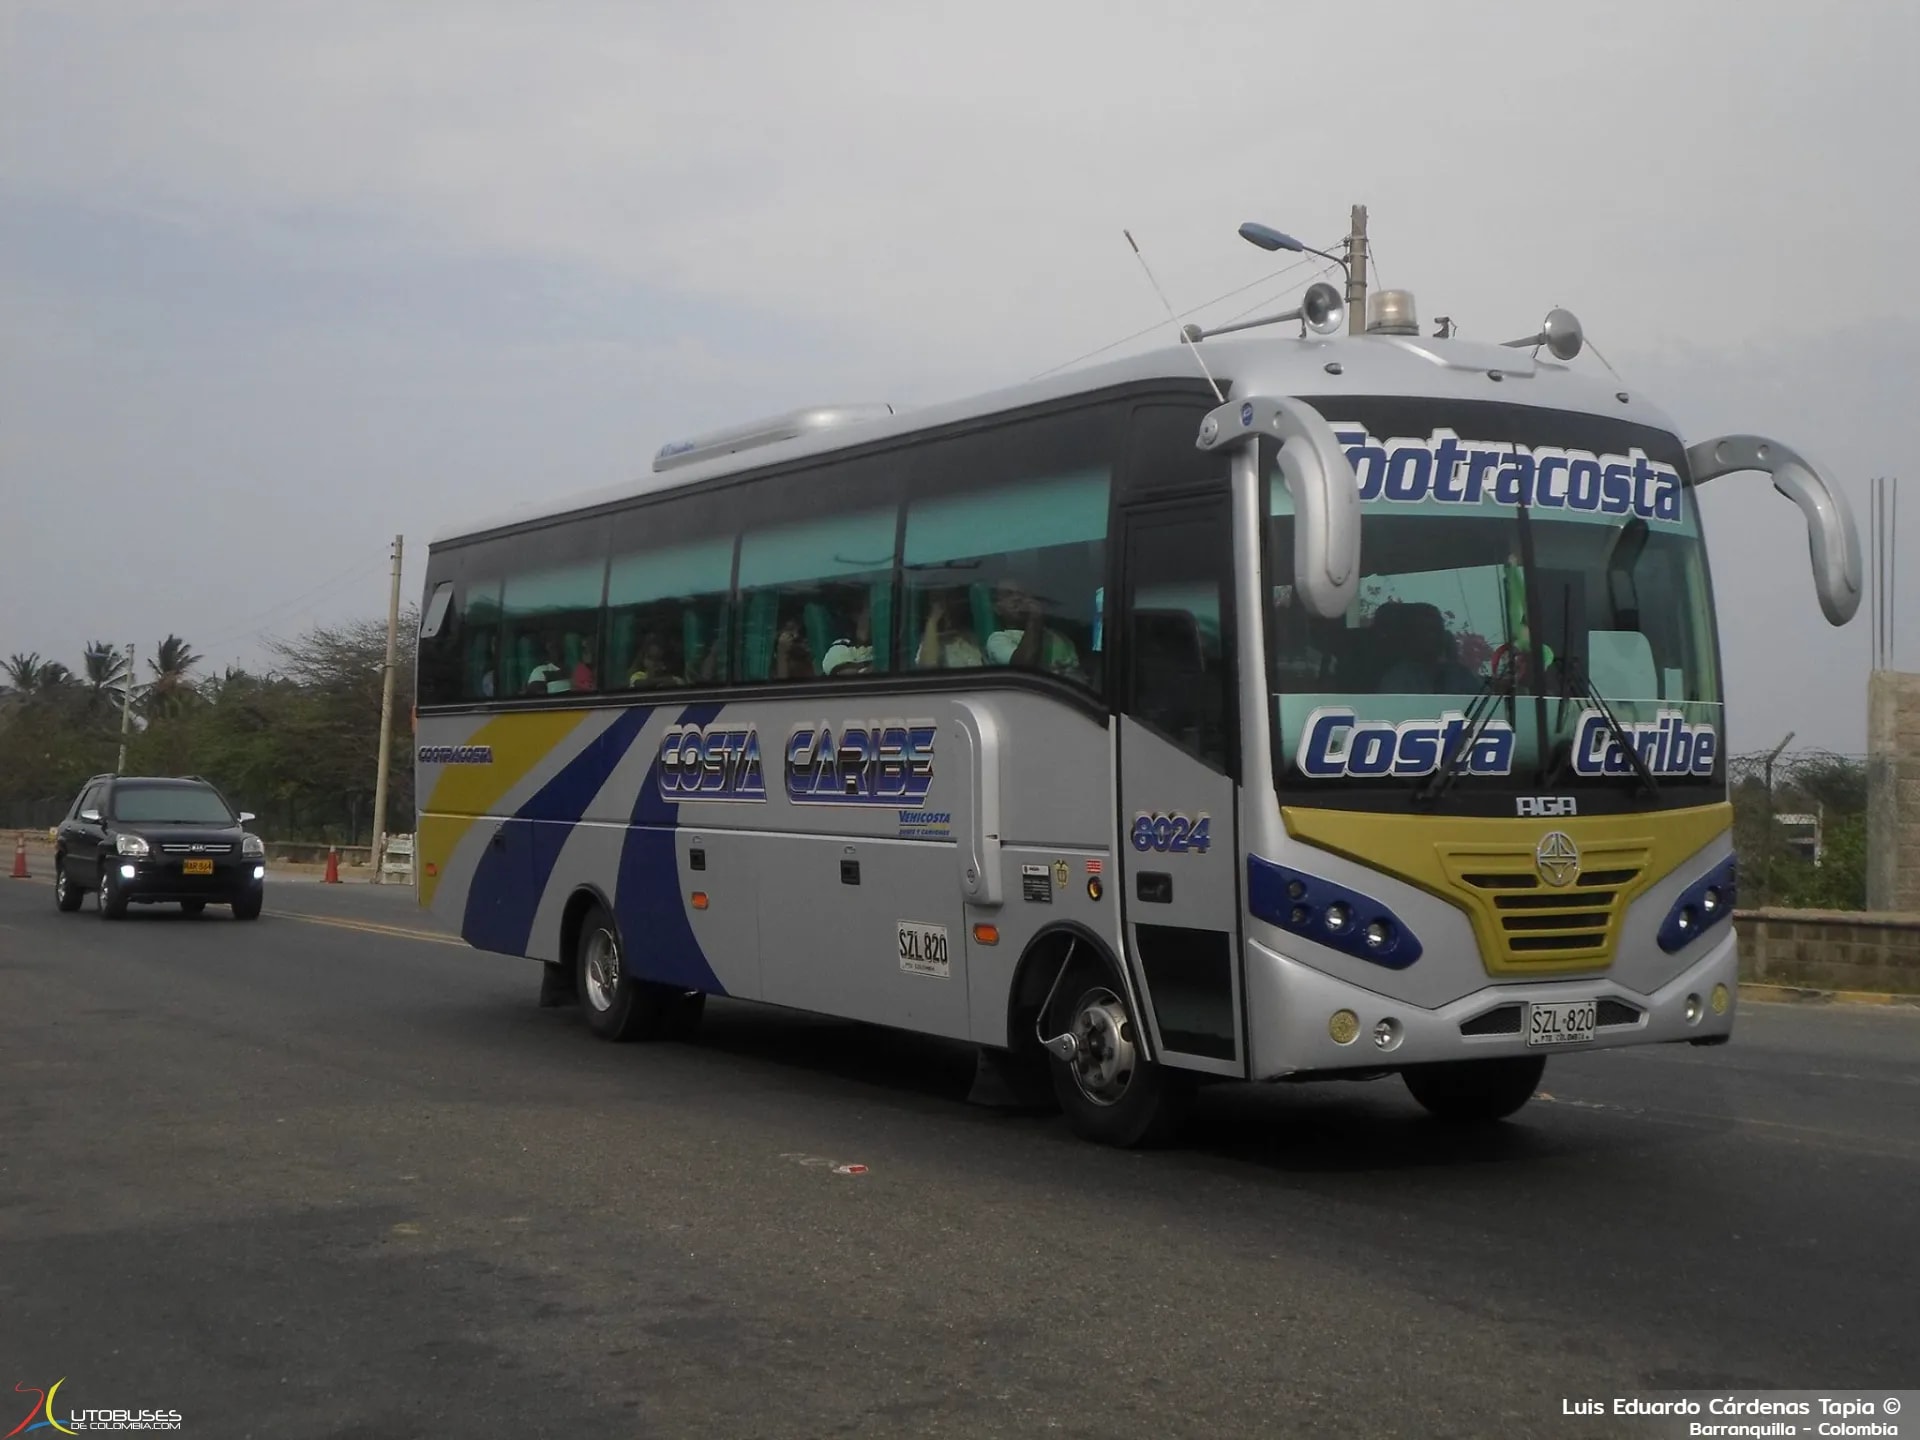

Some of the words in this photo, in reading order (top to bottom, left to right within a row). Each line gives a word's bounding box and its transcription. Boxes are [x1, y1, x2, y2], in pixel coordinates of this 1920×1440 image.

[1297, 706, 1515, 778] Costa
[1572, 708, 1717, 777] Caribe
[659, 721, 767, 804] COSTA
[785, 719, 938, 809] CARIBE
[898, 810, 951, 824] VEHICOSTA
[1516, 796, 1577, 816] AGA
[1132, 810, 1211, 854] 8024
[899, 929, 923, 960] SZL
[924, 932, 948, 963] 820
[1532, 1010, 1561, 1034] SZL
[1567, 1008, 1595, 1031] 820
